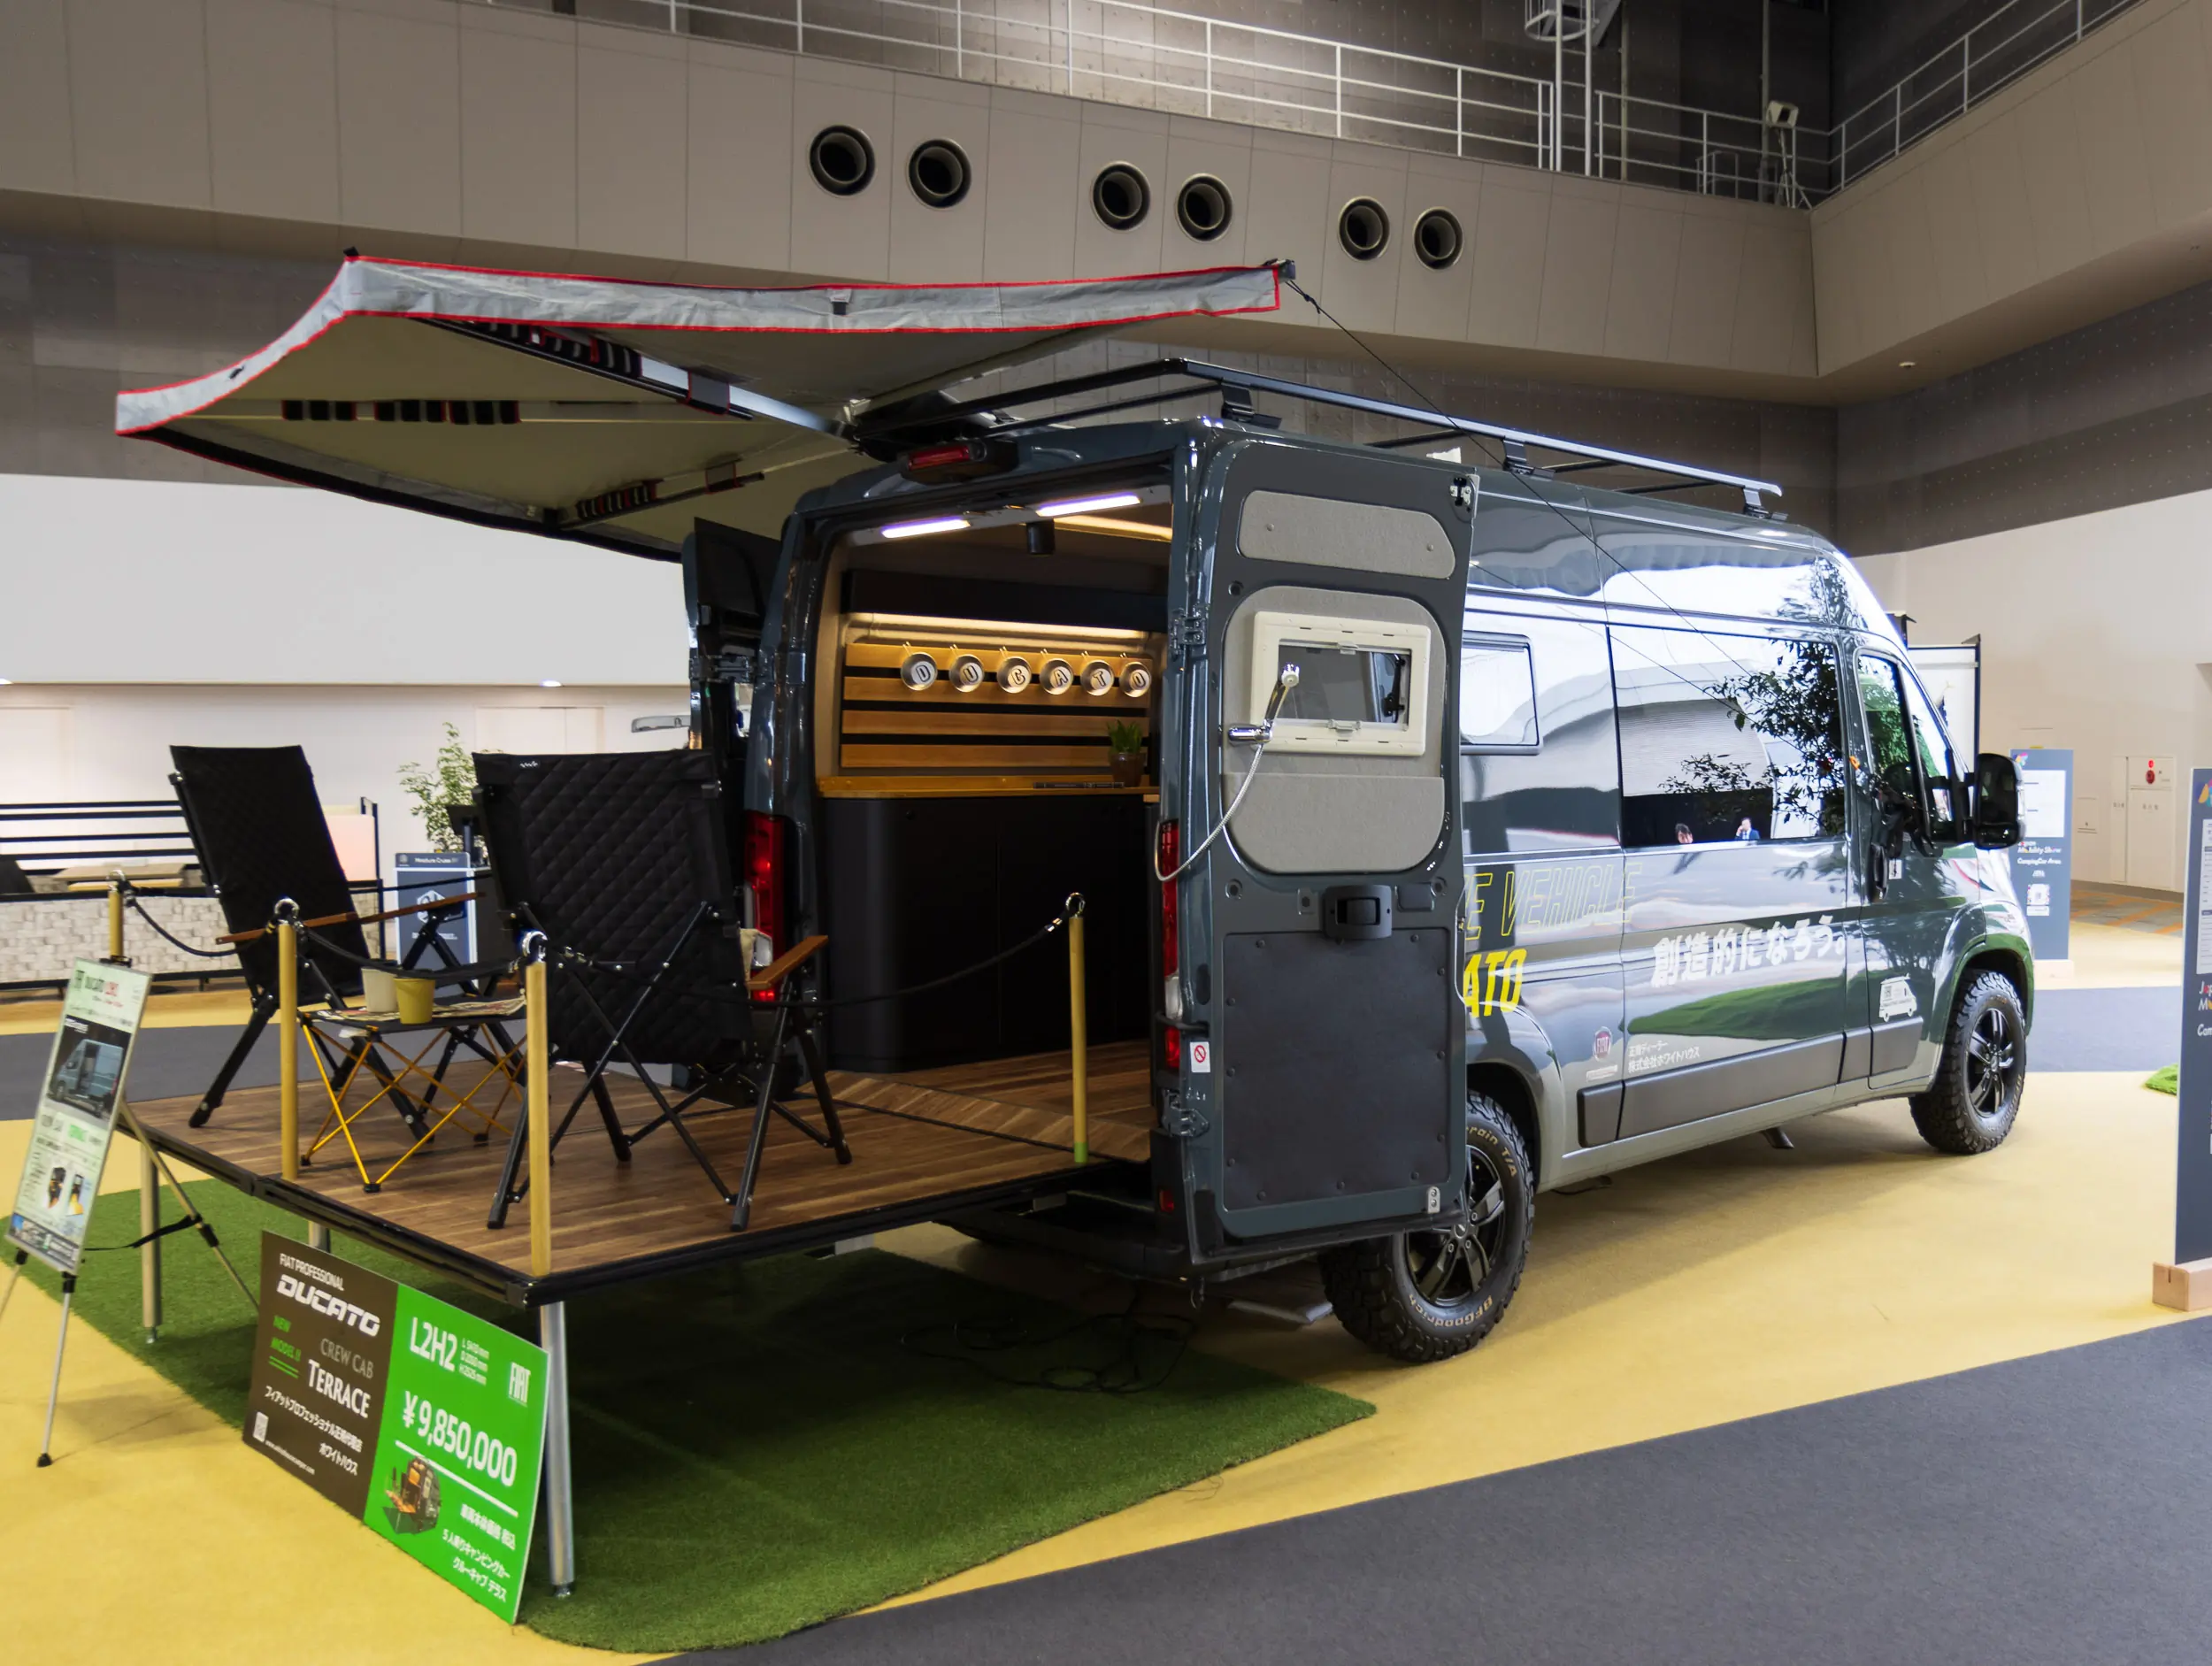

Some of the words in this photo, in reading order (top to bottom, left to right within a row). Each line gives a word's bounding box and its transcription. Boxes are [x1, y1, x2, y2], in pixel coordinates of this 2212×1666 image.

[1501, 862, 1643, 937] VEHICLE
[1466, 1126, 1498, 1145] rain
[279, 1253, 296, 1270] FIAT
[295, 1259, 345, 1292] PROFESSIONAL
[276, 1274, 380, 1337] DUCATO
[320, 1338, 351, 1366] CREW
[352, 1354, 374, 1379] CAB
[410, 1317, 458, 1372] L2H2
[308, 1358, 372, 1418] TERRACE
[509, 1362, 531, 1404] FIAT
[319, 1442, 359, 1476] ホワイトハウス
